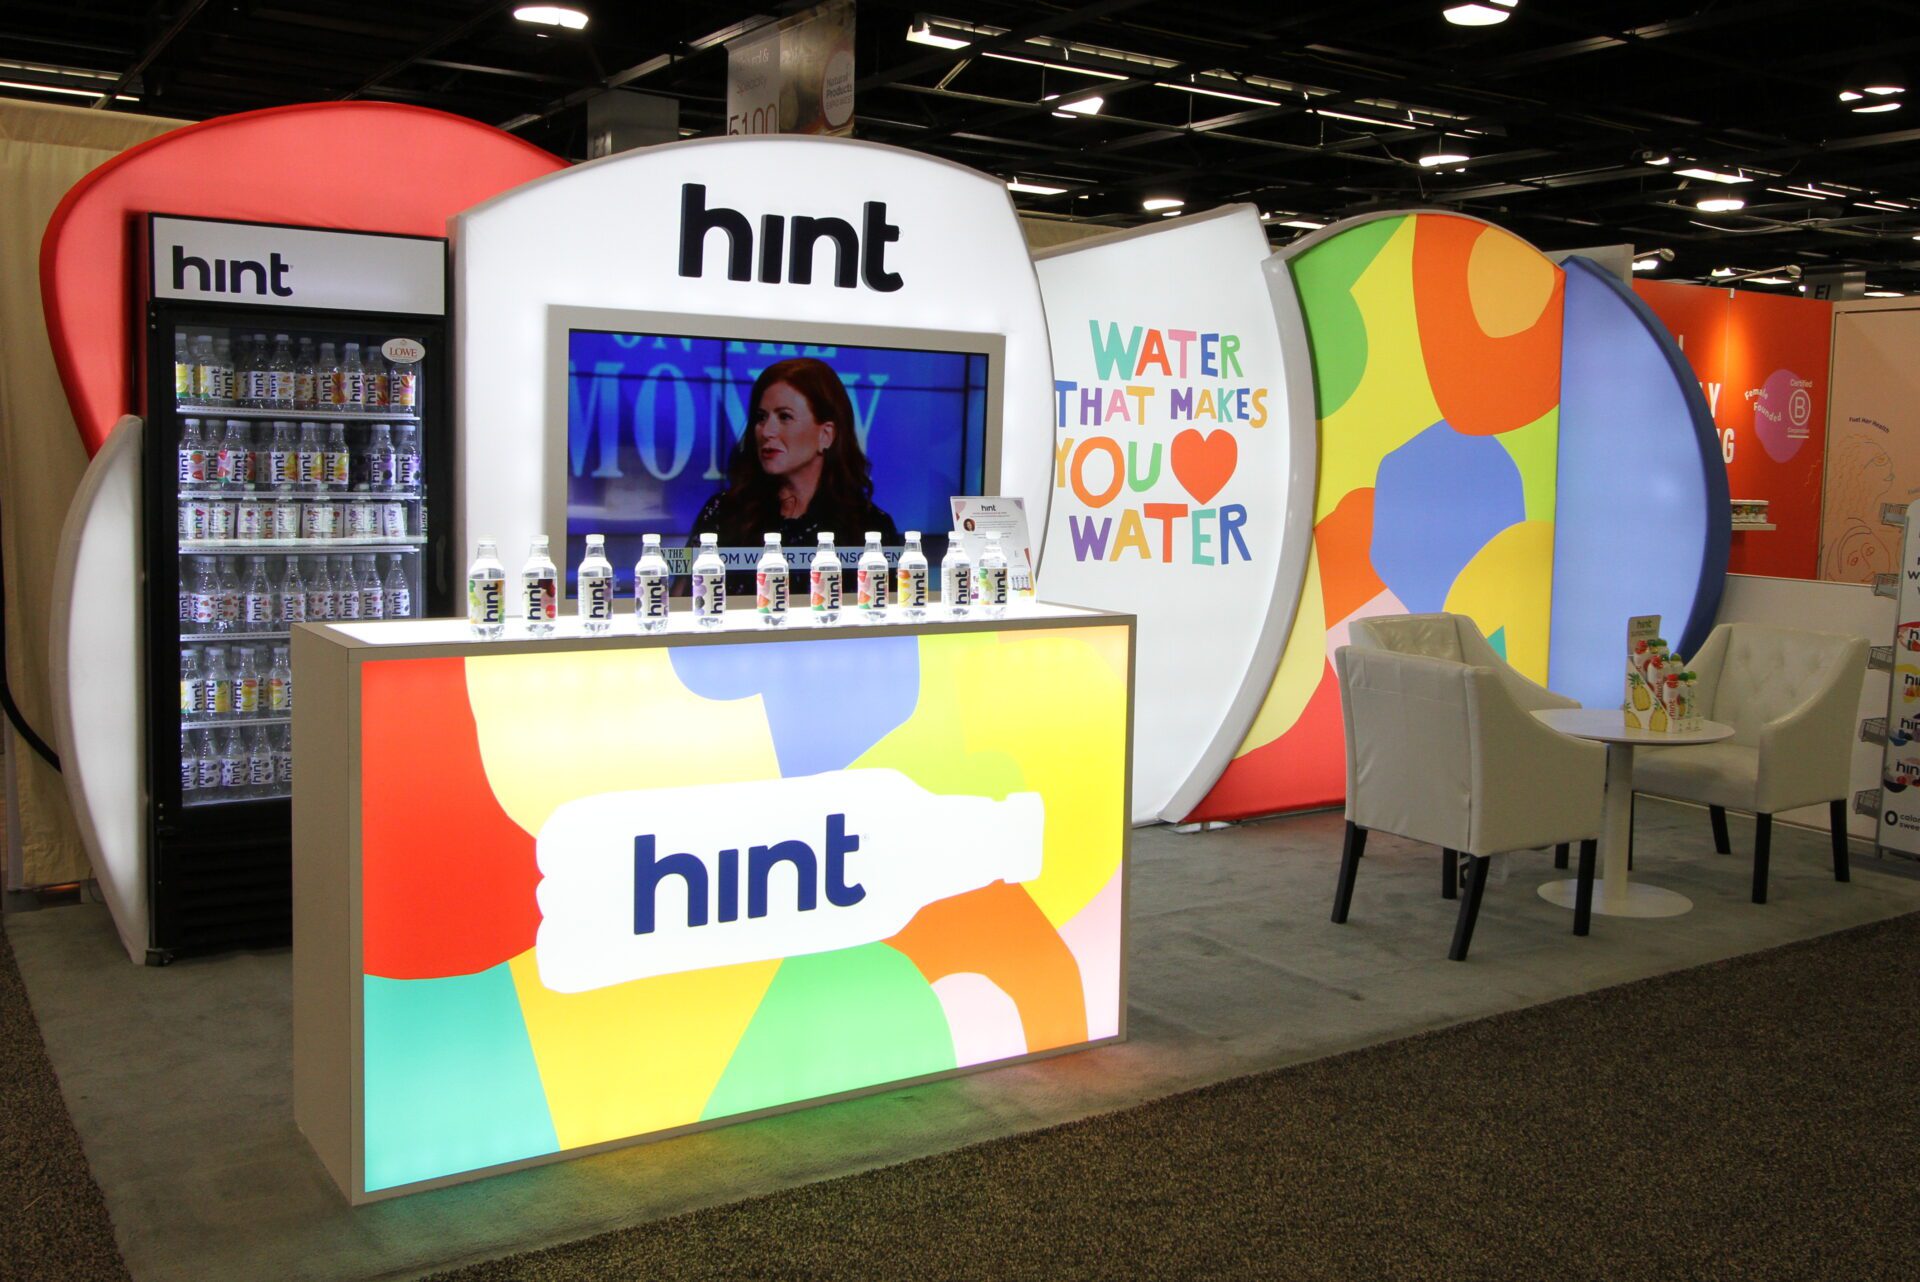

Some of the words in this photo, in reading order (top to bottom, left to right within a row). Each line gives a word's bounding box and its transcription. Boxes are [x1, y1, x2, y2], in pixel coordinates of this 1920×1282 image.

[679, 183, 904, 293] hint
[172, 245, 293, 297] hint
[390, 347, 417, 358] LOWE
[1089, 319, 1243, 381] WATER
[223, 370, 233, 399] hint
[254, 373, 263, 398] hint
[320, 375, 331, 402] hint
[350, 375, 360, 402] hint
[366, 377, 376, 404] hint
[391, 376, 400, 404] hint
[1055, 380, 1155, 427] THAT
[1170, 387, 1268, 428] MAKES
[568, 360, 889, 481] MONY
[231, 452, 243, 481] hint
[273, 453, 285, 482] hint
[301, 454, 311, 482] hint
[325, 454, 335, 482] hint
[400, 456, 410, 483] hint
[1055, 436, 1162, 509] YOU
[981, 504, 996, 512] hint
[1069, 504, 1252, 566] WATER
[667, 560, 691, 573] NEY
[668, 549, 684, 559] THE
[527, 582, 541, 620] hint
[589, 579, 604, 618] hint
[647, 578, 662, 616] hint
[710, 576, 723, 614] hint
[773, 576, 785, 612] hint
[827, 574, 839, 610] hint
[873, 573, 885, 608] hint
[913, 571, 925, 606] hint
[955, 570, 967, 605] hint
[994, 569, 1005, 604] hint
[252, 597, 262, 620] hint
[284, 596, 294, 620] hint
[343, 593, 352, 617] hint
[364, 592, 372, 616] hint
[392, 591, 400, 616] hint
[482, 582, 498, 622] hint
[192, 683, 203, 711] hint
[206, 682, 215, 712] hint
[231, 760, 240, 784] hint
[252, 759, 261, 783] hint
[634, 813, 866, 935] hint
